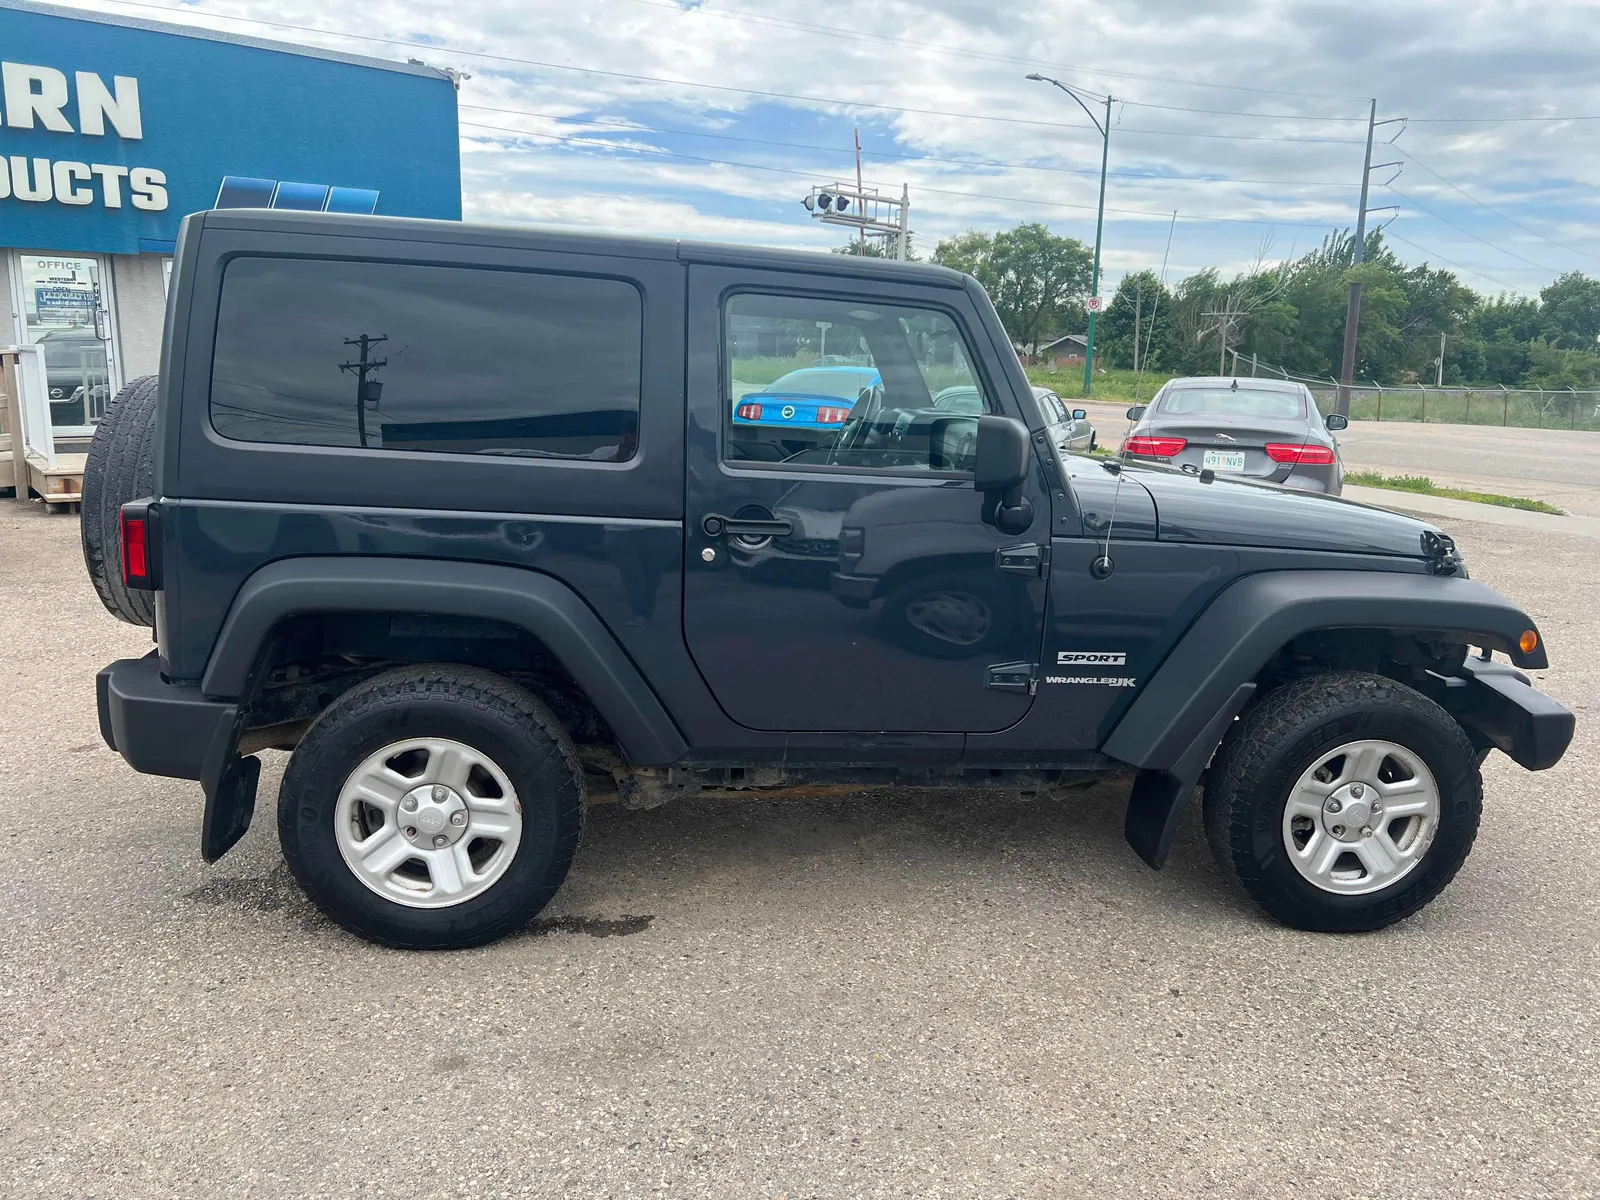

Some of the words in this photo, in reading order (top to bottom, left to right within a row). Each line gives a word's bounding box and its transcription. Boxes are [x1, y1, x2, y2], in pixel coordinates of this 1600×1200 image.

[0, 61, 142, 139] RN
[0, 153, 168, 211] UCTS
[37, 260, 82, 271] OFFICE
[1205, 456, 1220, 466] 491
[1226, 457, 1243, 467] NVB
[1058, 653, 1126, 664] SPORT
[1046, 676, 1117, 684] WRANGLER
